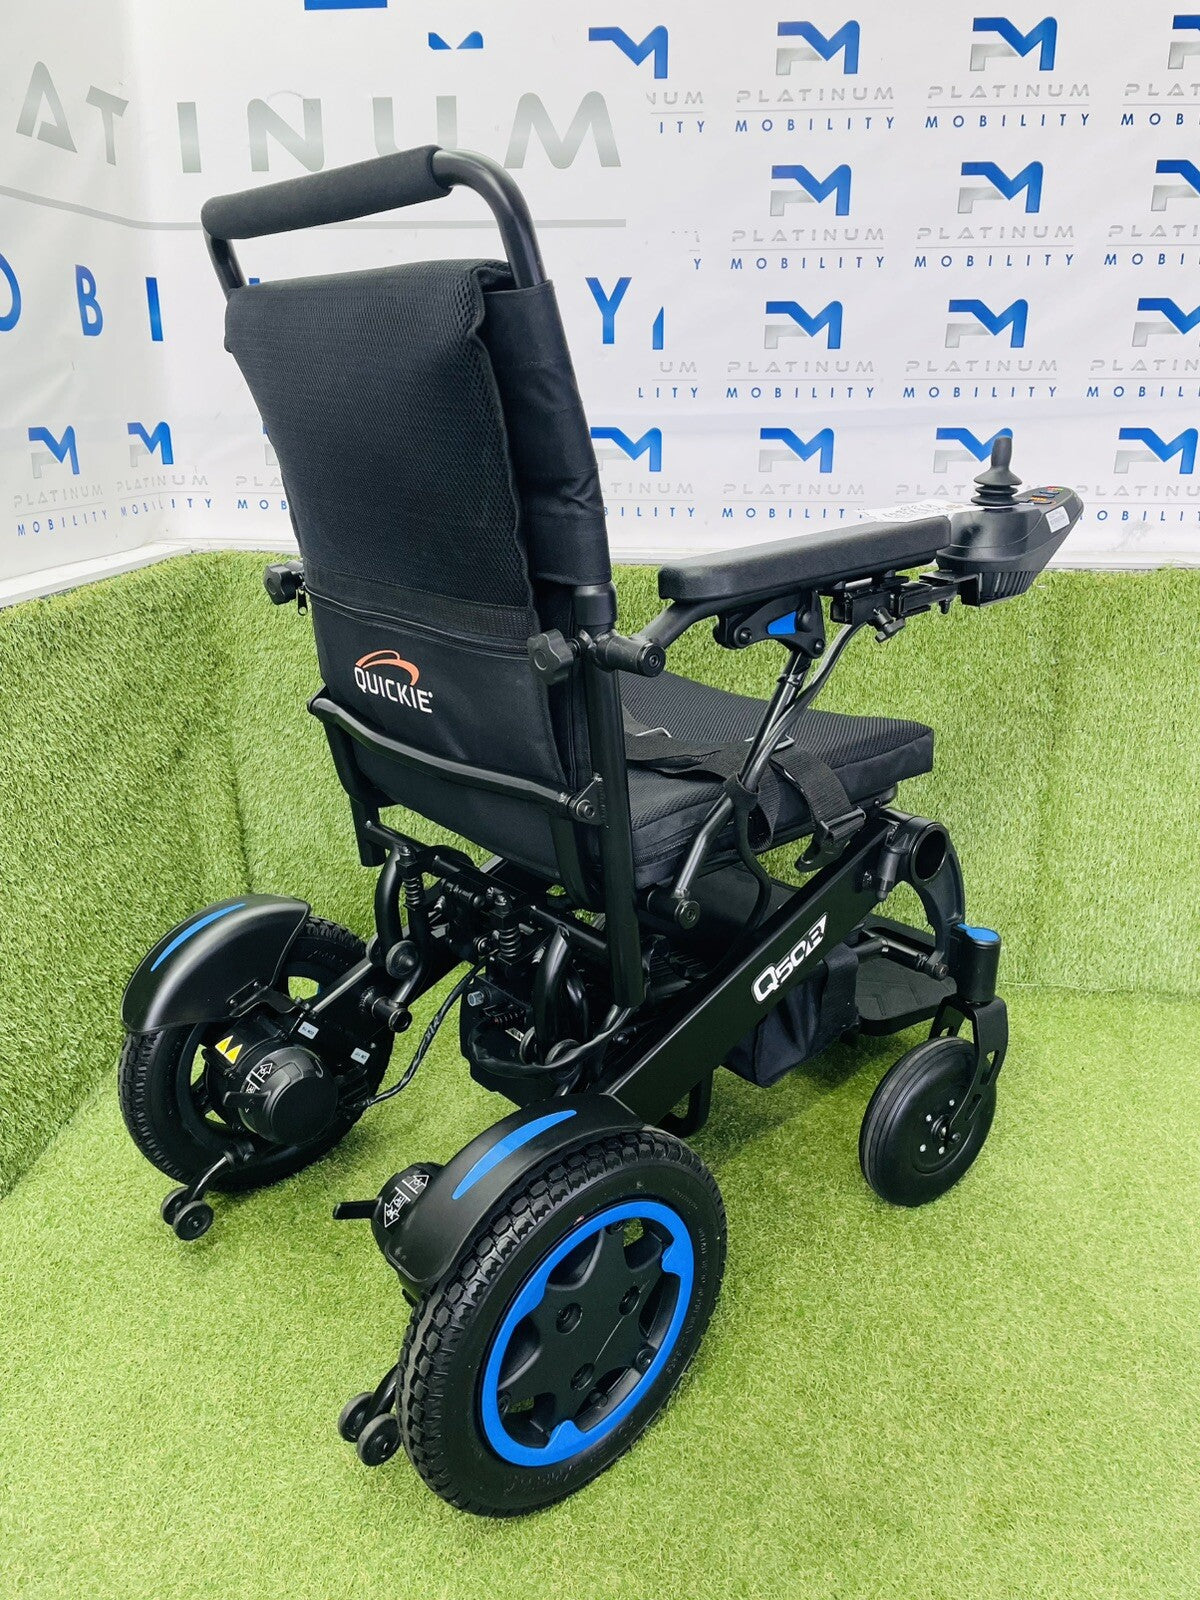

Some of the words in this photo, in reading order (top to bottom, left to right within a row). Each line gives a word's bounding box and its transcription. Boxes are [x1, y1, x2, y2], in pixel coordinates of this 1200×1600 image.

[737, 87, 894, 103] PLATINUM
[928, 84, 1090, 98] PLATINUM
[658, 120, 705, 134] ITY
[735, 116, 895, 132] MOBILITY
[925, 113, 1089, 128] MOBILITY
[731, 228, 884, 242] PLATINUM
[917, 226, 1074, 240] PLATINUM
[730, 256, 884, 270] MOBILITY
[914, 254, 1074, 268] MOBILITY
[727, 361, 875, 373] PLATINUM
[905, 359, 1058, 372] PLATINUM
[638, 387, 699, 399] LITY
[726, 387, 875, 399] MOBILITY
[903, 386, 1057, 398] MOBILITY
[116, 473, 209, 492] PLATINUM
[14, 484, 103, 508] PLATINUM
[722, 484, 865, 496] PLATINUM
[120, 498, 212, 518] MOBILITY
[17, 509, 108, 537] MOBILITY
[354, 666, 434, 713] QUICKIE
